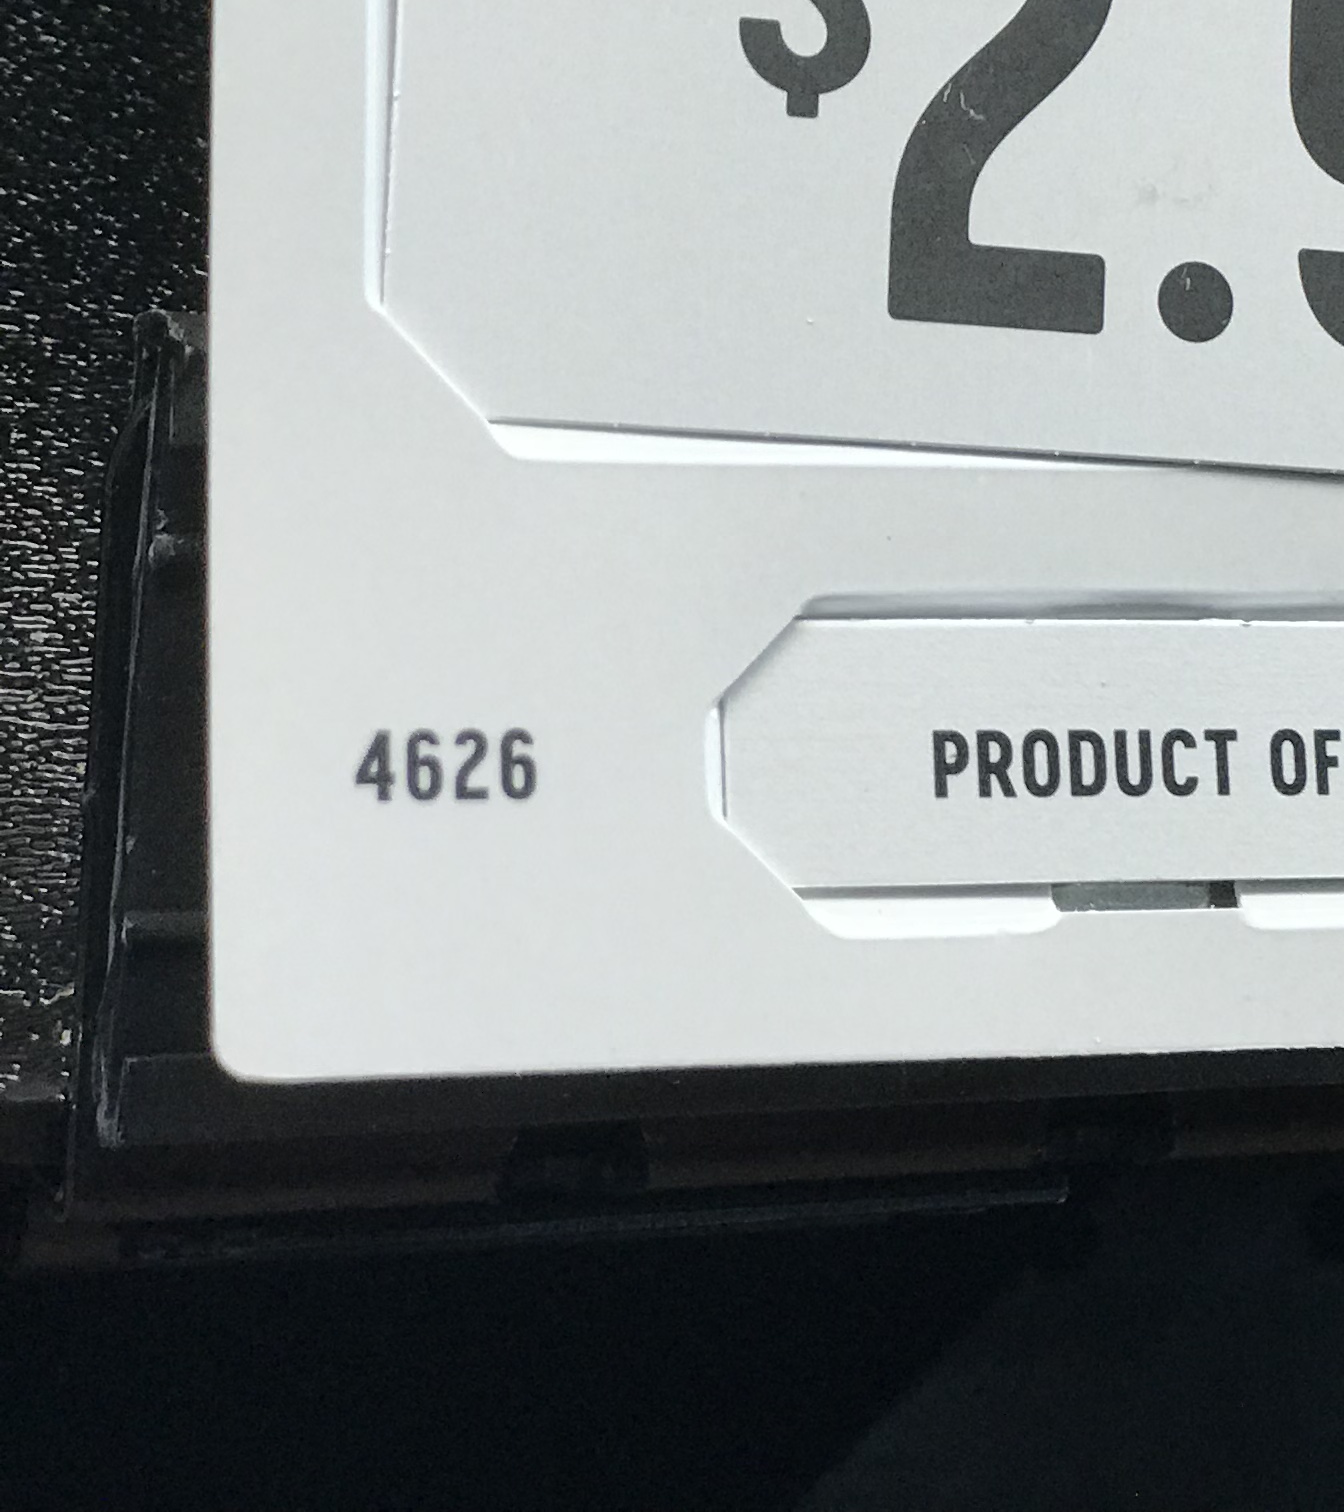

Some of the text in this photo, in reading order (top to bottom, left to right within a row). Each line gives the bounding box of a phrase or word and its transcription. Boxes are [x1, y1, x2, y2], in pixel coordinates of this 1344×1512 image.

[355, 730, 536, 801] 4626
[931, 728, 1239, 799] PRODUCT
[1269, 728, 1342, 797] OF
